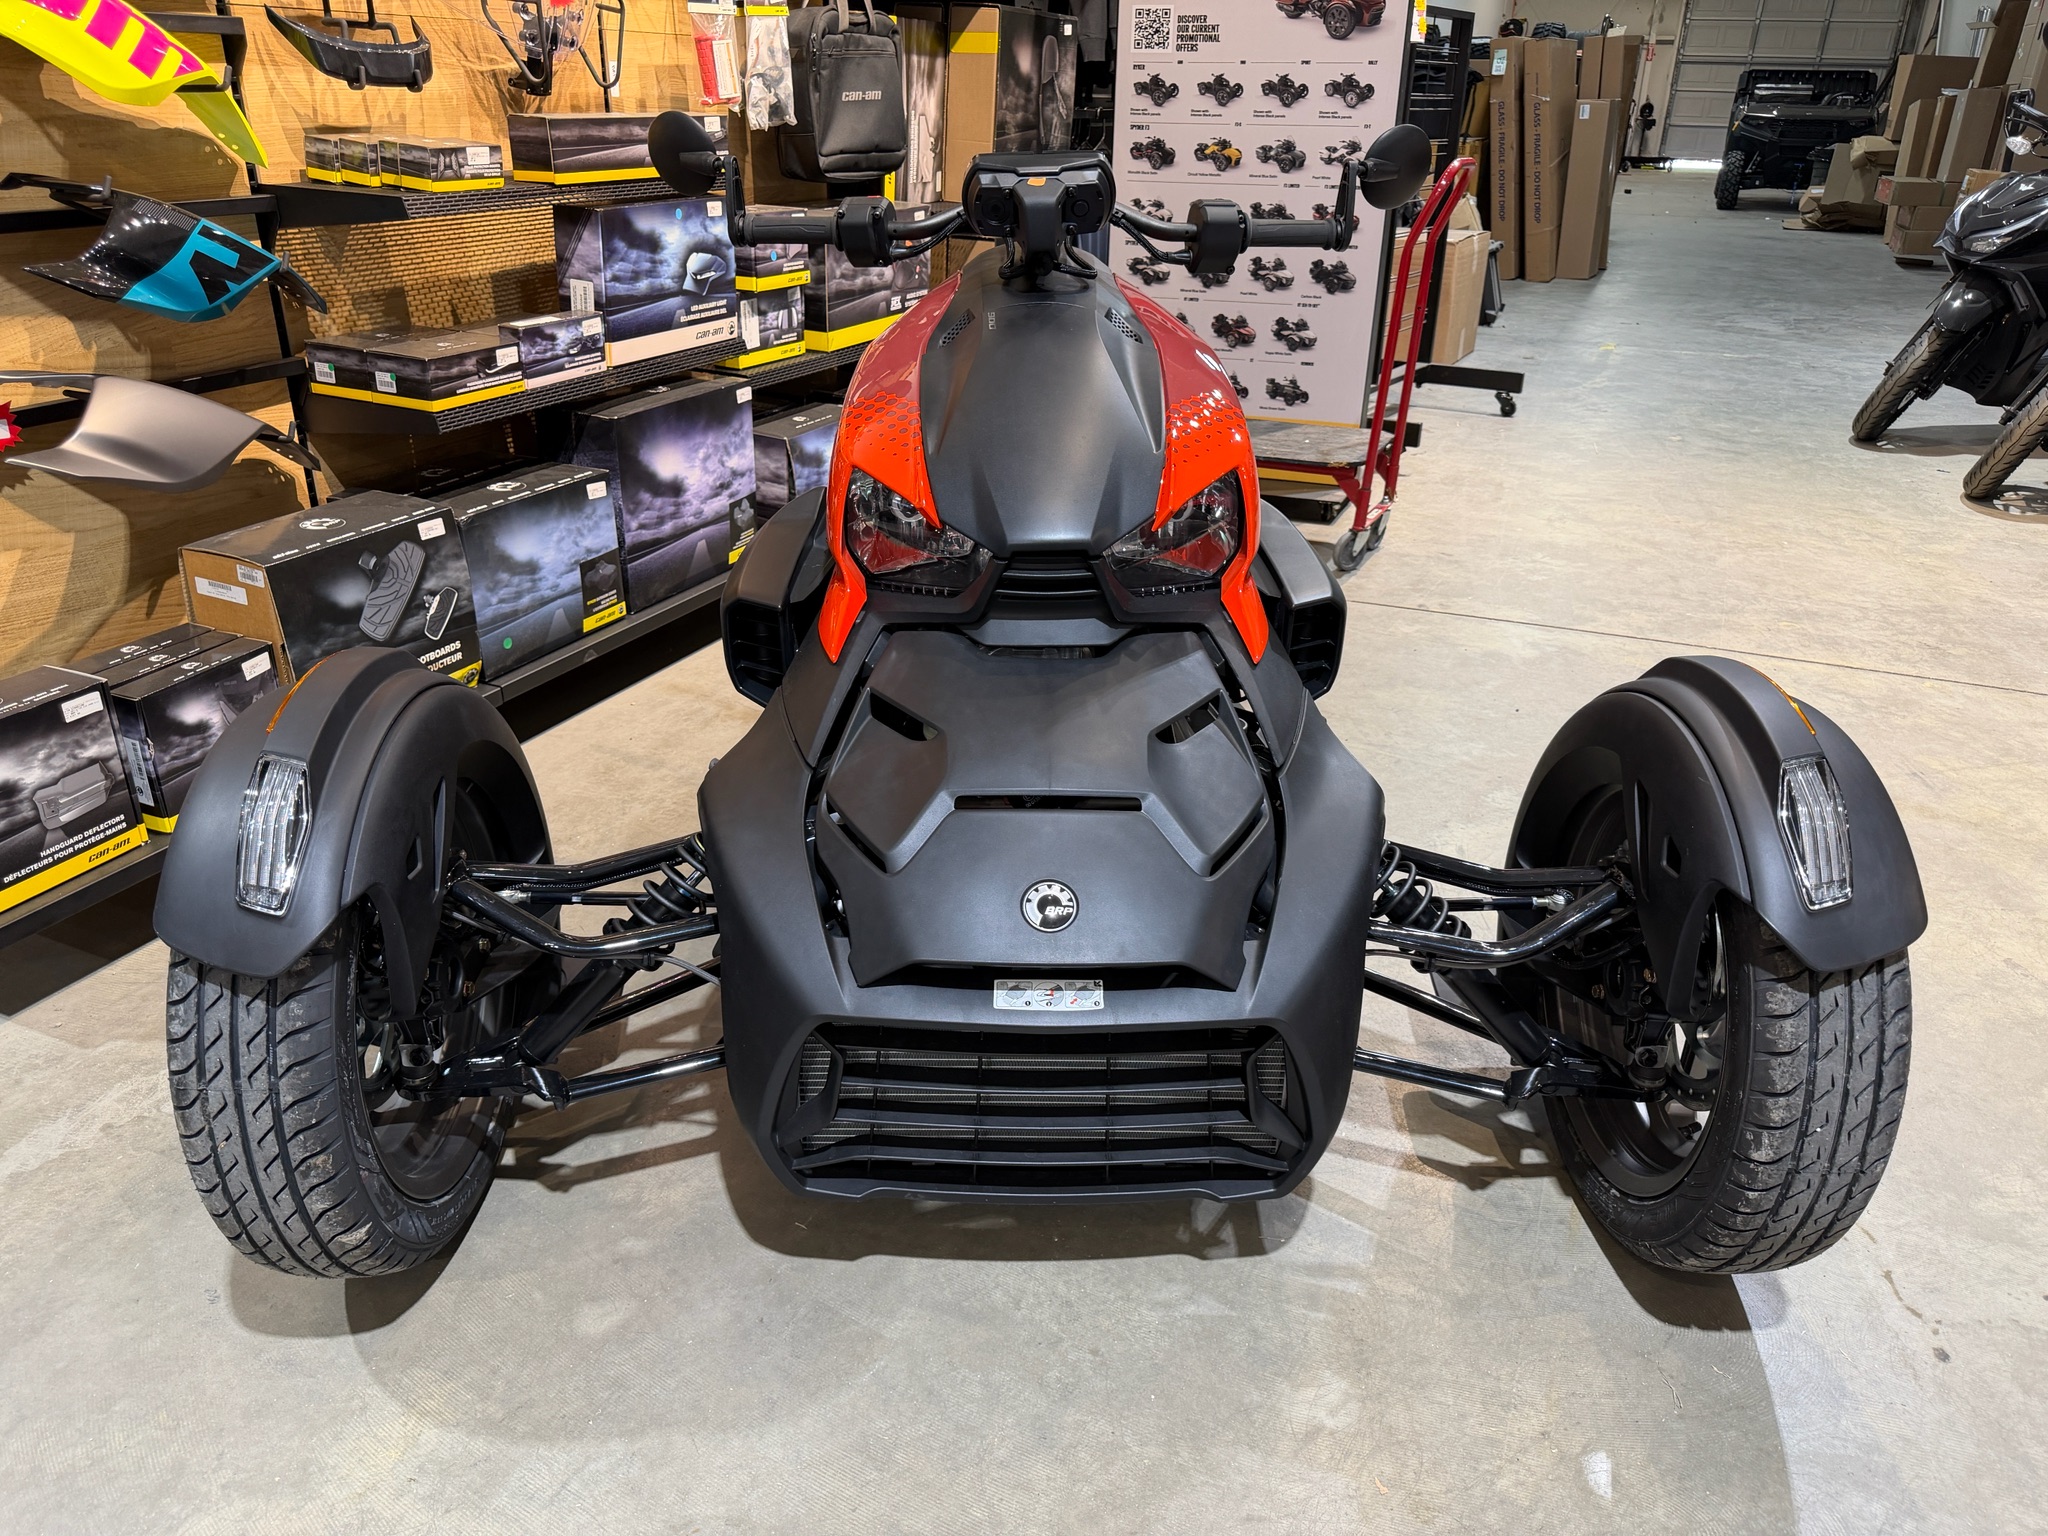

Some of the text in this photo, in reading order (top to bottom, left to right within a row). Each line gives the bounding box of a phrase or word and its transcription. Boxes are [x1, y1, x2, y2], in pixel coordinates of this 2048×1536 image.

[1177, 15, 1207, 23] DISCOVER
[1177, 24, 1220, 33] OUR CURRENT
[1176, 34, 1220, 42] PROMOTIONAL
[1176, 44, 1198, 52] OFFERS
[842, 91, 881, 101] can-am
[1499, 170, 1505, 181] DO
[1534, 171, 1541, 183] DO
[696, 327, 724, 339] can-am
[417, 641, 461, 664] OTBOARDS
[40, 814, 125, 858] HANDGUARD DEFLECTORS
[3, 822, 127, 883] DÉFLECTEURS POUR PROTÈGE-MAINS
[88, 838, 130, 863] can-am
[1045, 906, 1073, 916] BRP
